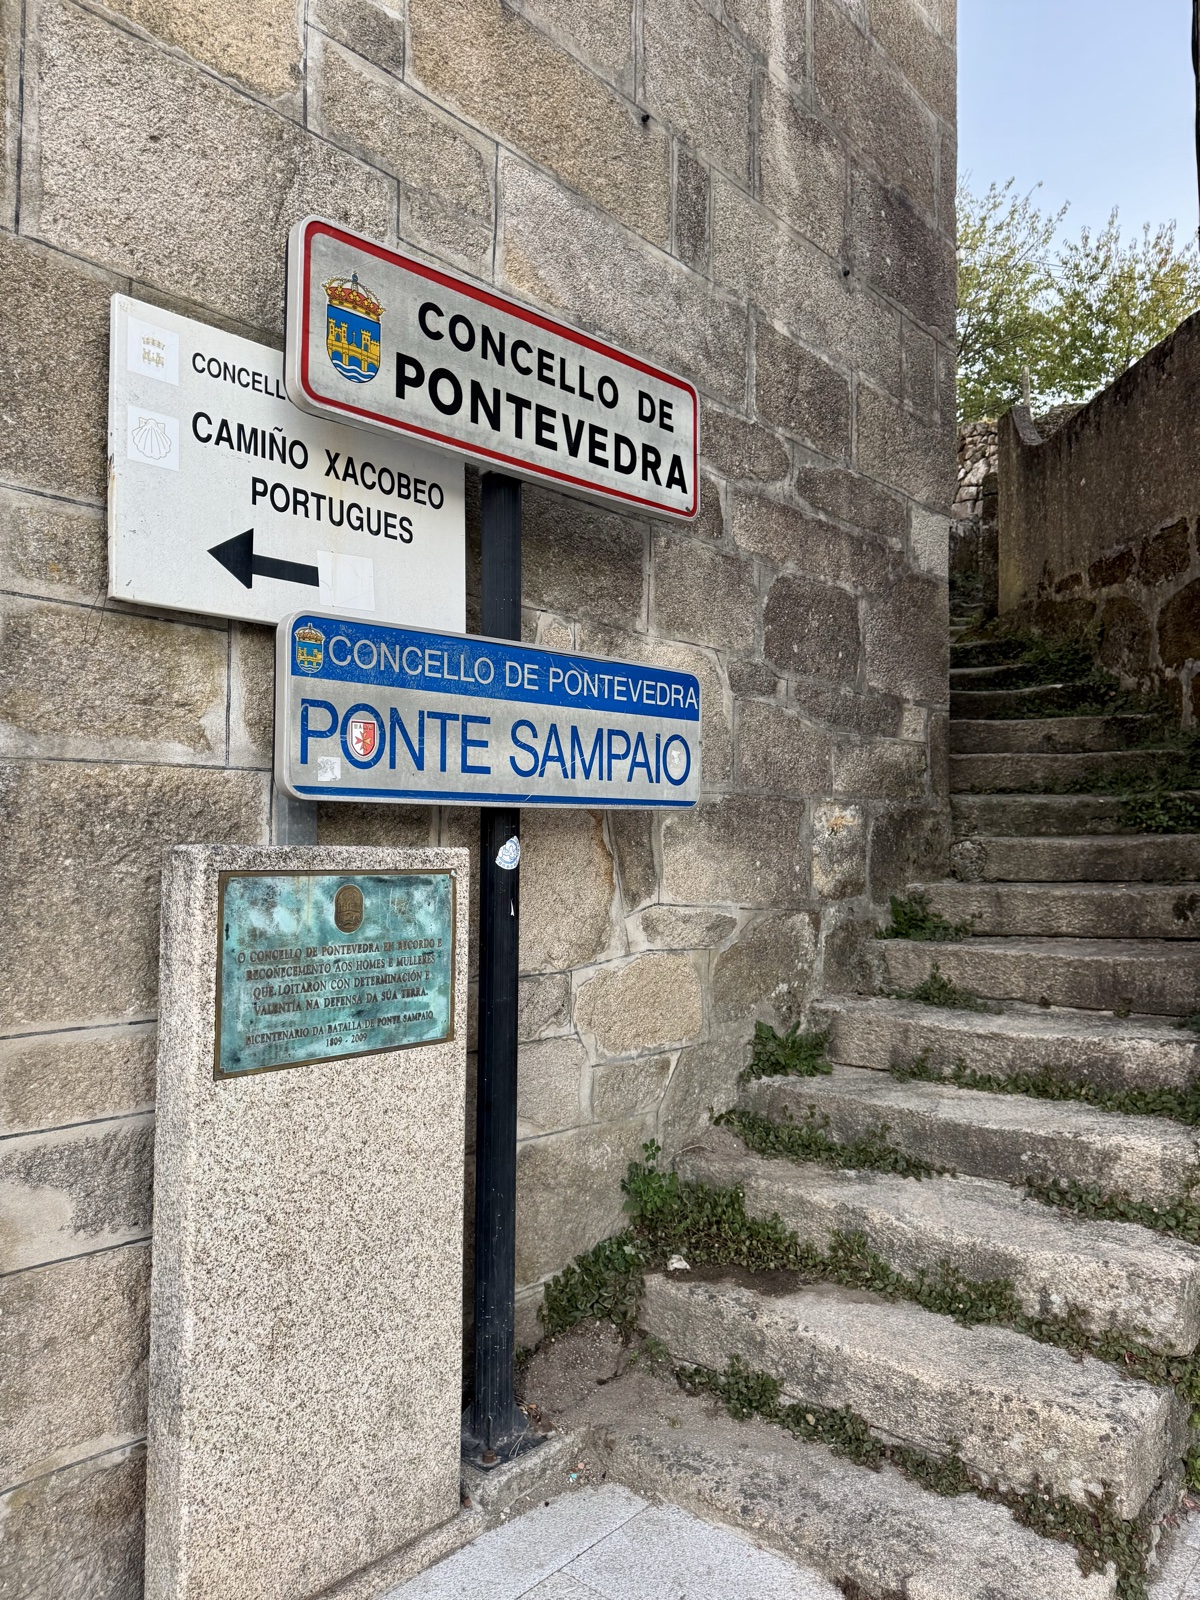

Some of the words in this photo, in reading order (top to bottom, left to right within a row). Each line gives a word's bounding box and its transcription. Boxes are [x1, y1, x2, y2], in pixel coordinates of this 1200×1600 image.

[192, 352, 286, 400] CONCELL
[418, 302, 619, 409] CONCELLO
[638, 389, 674, 433] DE
[395, 351, 688, 495] PONTEVEDRA
[192, 411, 309, 470] CAMIÑO
[324, 449, 444, 510] XACOBEO
[251, 476, 414, 544] PORTUGUES
[328, 636, 495, 685] CONCELLO
[505, 660, 539, 691] DE
[549, 667, 698, 710] PONTEVEDRA
[300, 698, 491, 775] PONTE
[509, 719, 691, 786] SAMPAIO
[237, 952, 246, 963] O
[249, 948, 302, 962] CONCELLO
[306, 946, 318, 958] DE
[321, 943, 380, 956] PONTEVEDRA
[383, 942, 395, 952] EN
[397, 939, 435, 950] RECORDO
[437, 938, 442, 947] E
[246, 963, 331, 981] RECOÑECEMENTO
[335, 961, 353, 972] AOS
[356, 959, 385, 970] HOMES
[388, 957, 393, 967] E
[396, 954, 435, 967] MULLERES
[278, 980, 327, 996] LOITARON
[330, 979, 350, 990] CON
[353, 970, 422, 988] DETERMINACIÓN
[425, 970, 430, 980] E
[306, 999, 320, 1010] NA
[323, 994, 363, 1008] DEFENSA
[366, 993, 380, 1004] DA
[381, 988, 398, 1001] SÚA
[401, 987, 429, 999] TERRA.
[245, 1027, 309, 1046] BICENTENARIO
[312, 1026, 324, 1036] DA
[327, 1021, 362, 1034] BATALLA
[364, 1019, 374, 1029] DE
[377, 1014, 401, 1027] PONTE
[403, 1010, 434, 1023] SAMPAIO
[326, 1036, 343, 1047] 1809
[350, 1032, 368, 1043] 2009
